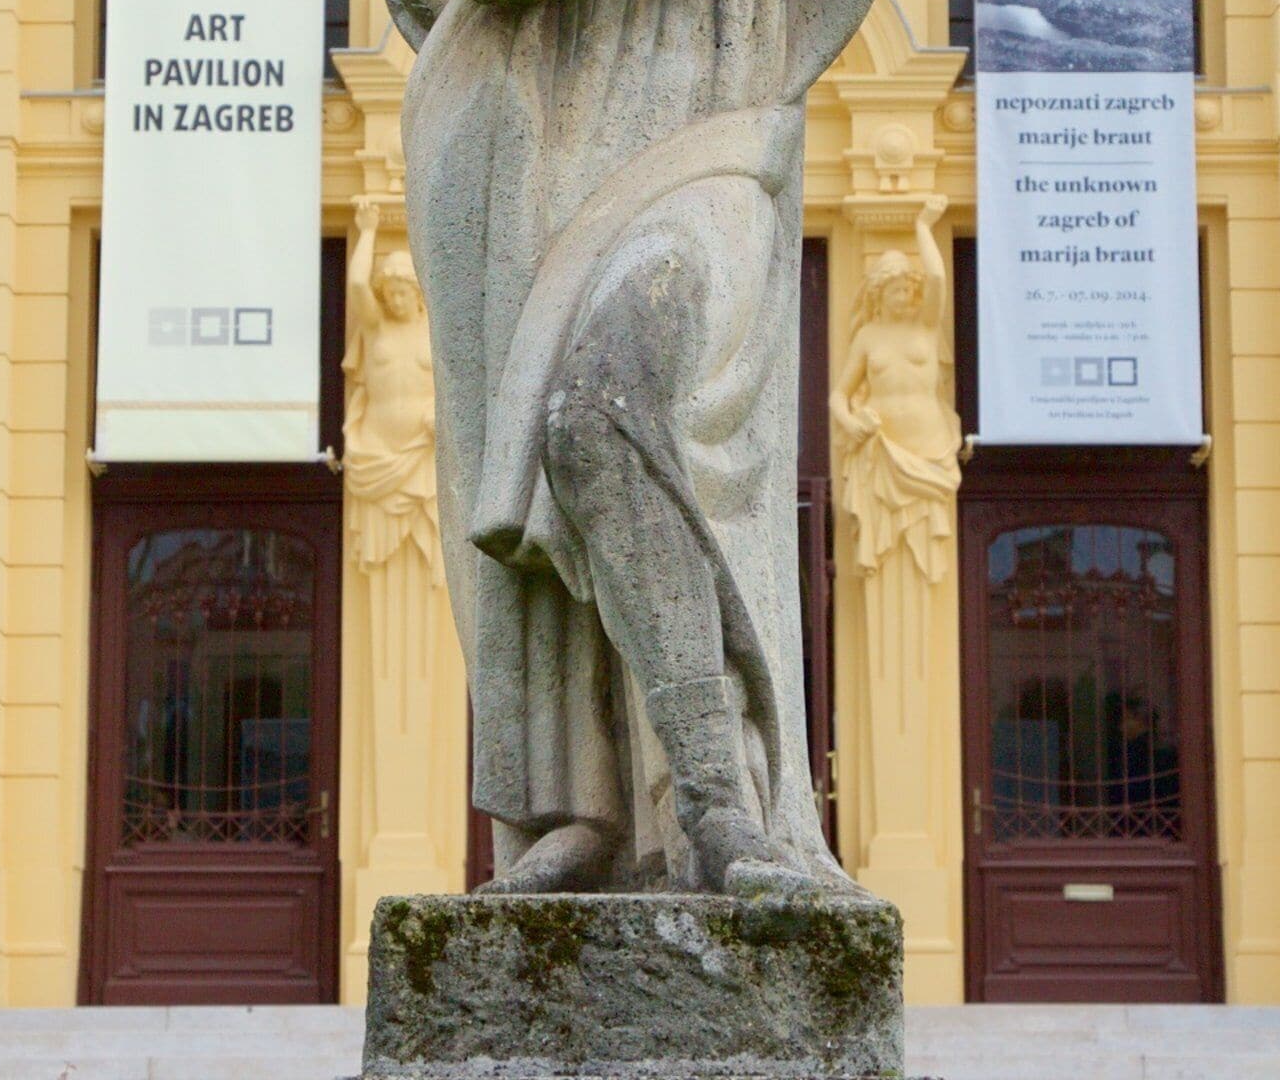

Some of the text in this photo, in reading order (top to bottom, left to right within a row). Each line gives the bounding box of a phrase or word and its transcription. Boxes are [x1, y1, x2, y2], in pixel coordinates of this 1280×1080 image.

[183, 13, 246, 42] ART
[144, 58, 285, 88] PAVILION
[995, 93, 1175, 114] nepoznati zagreb
[133, 103, 295, 133] IN ZAGREB
[1018, 128, 1152, 150] marije braut
[1015, 175, 1158, 193] the unknown
[1037, 209, 1141, 233] zagreb of
[1019, 245, 1154, 267] marija braut
